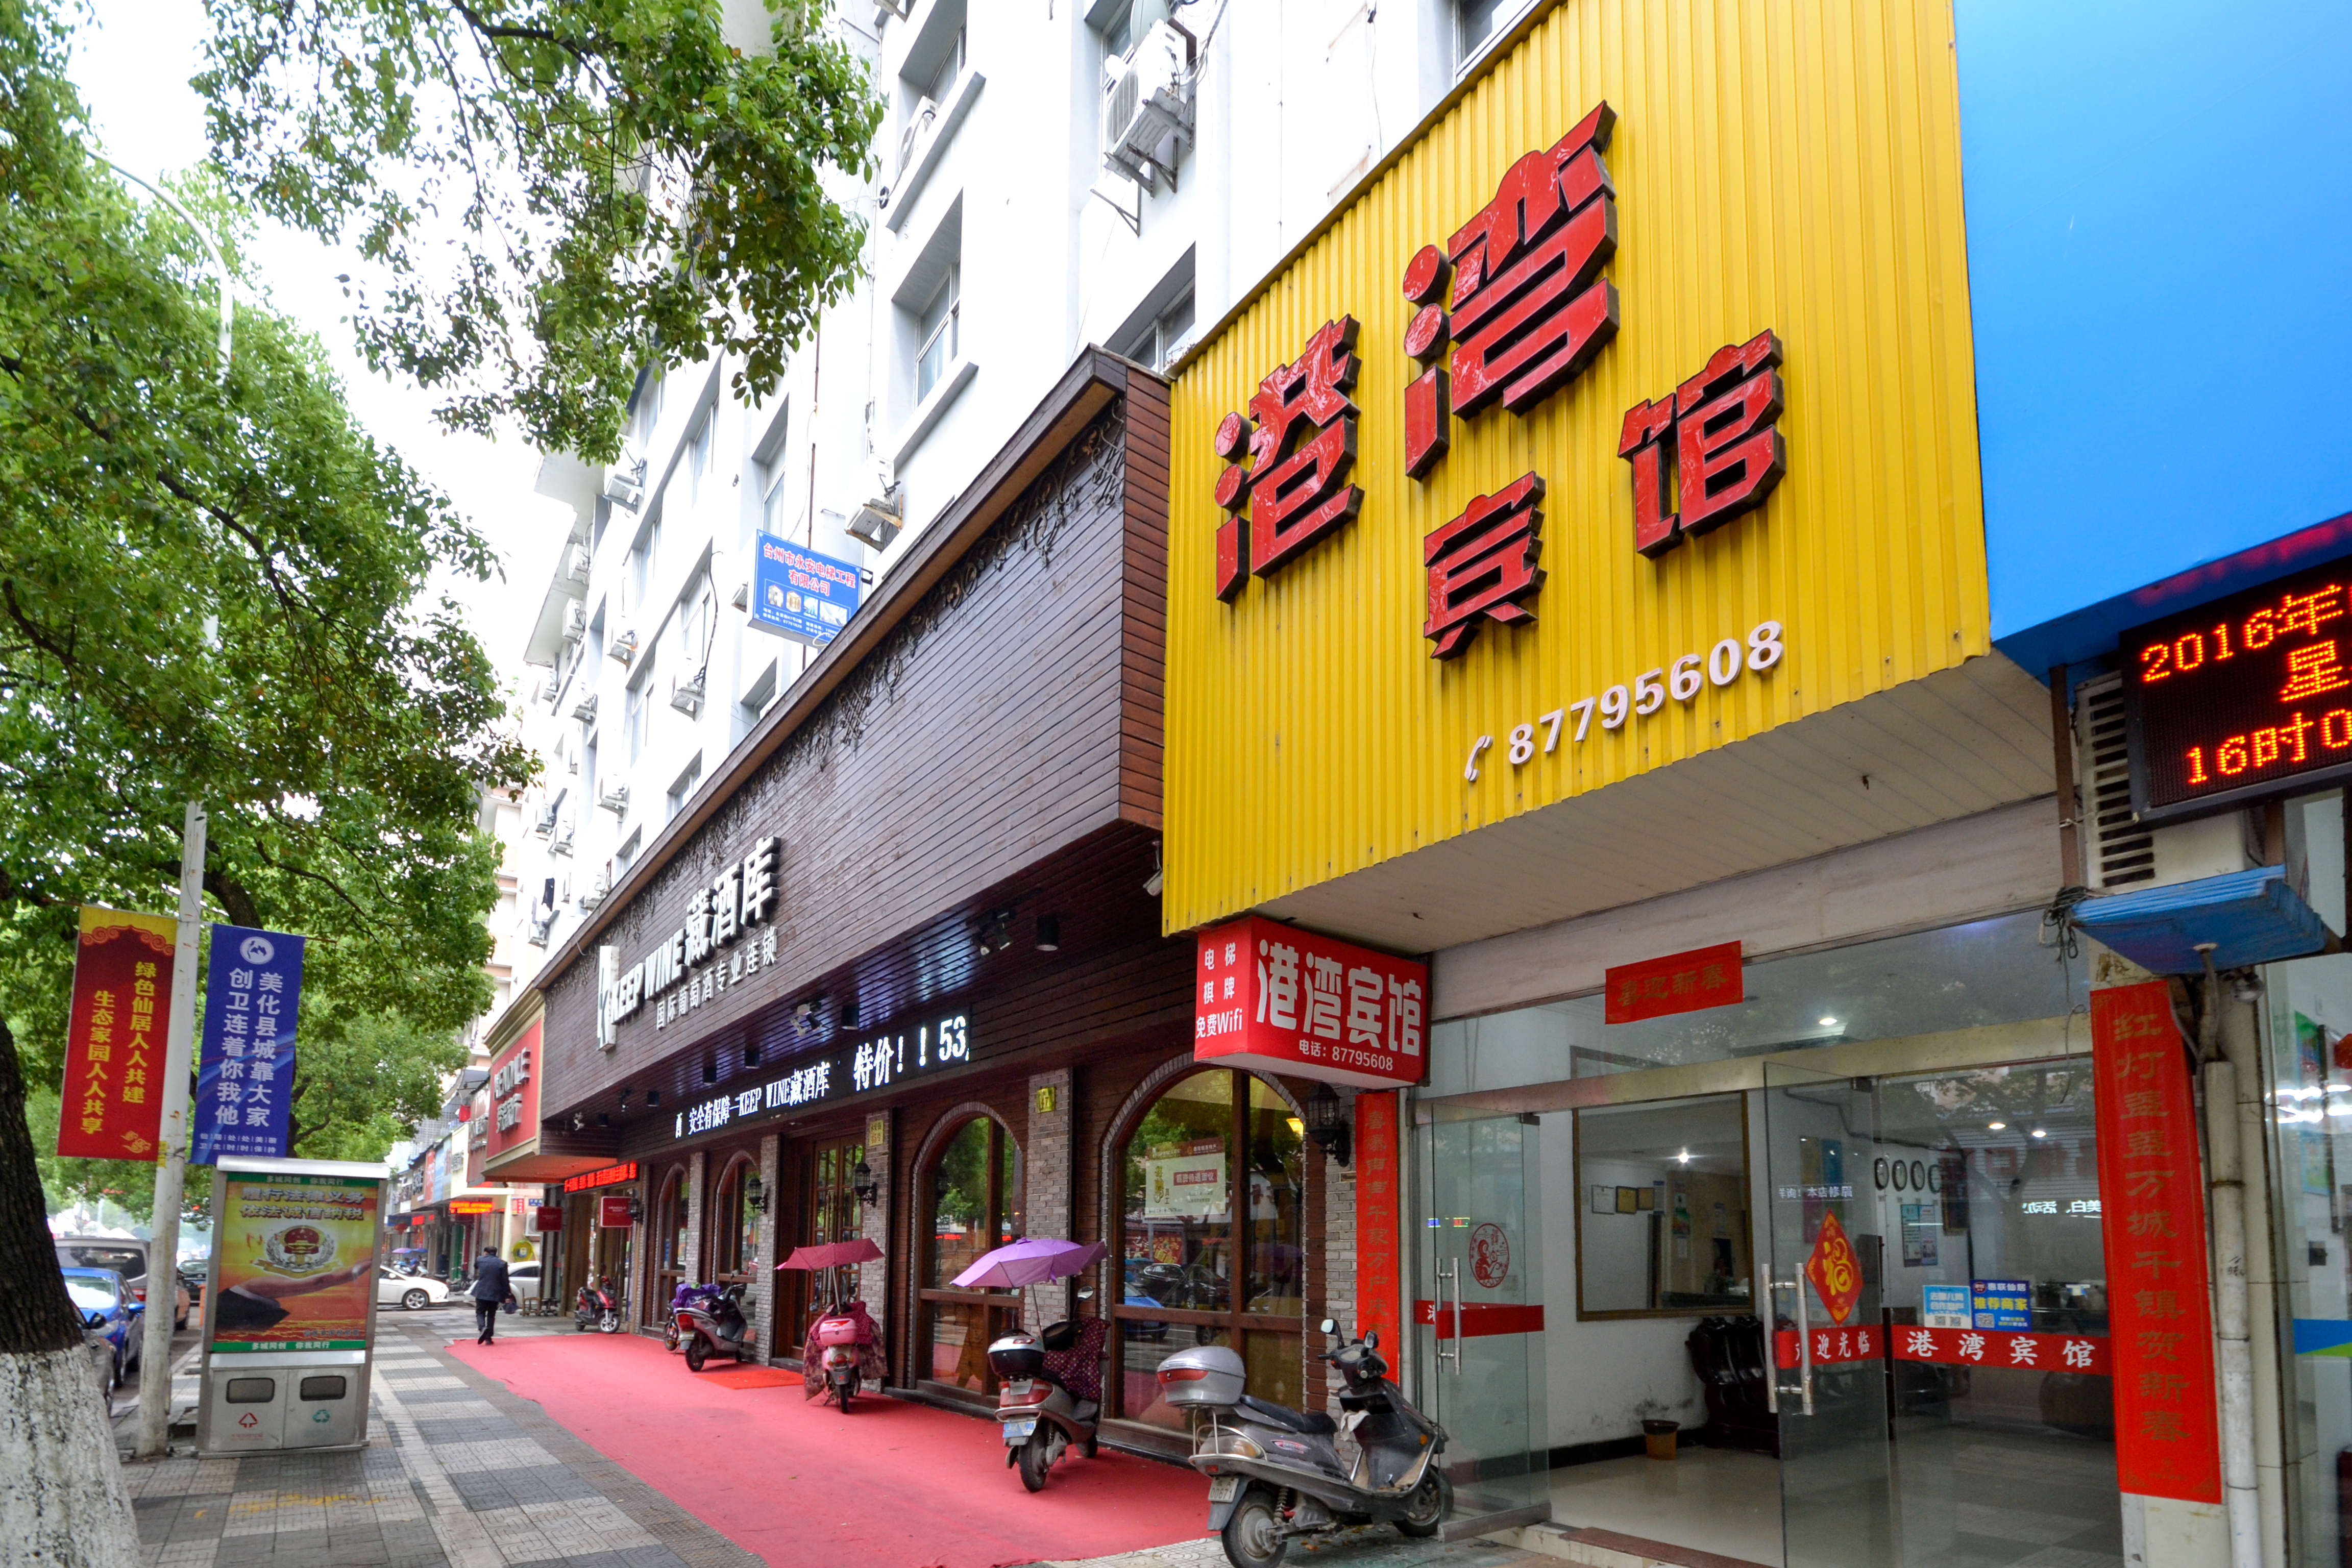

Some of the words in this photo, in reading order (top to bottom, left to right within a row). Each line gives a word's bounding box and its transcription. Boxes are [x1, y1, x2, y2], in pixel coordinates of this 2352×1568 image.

[764, 543, 856, 588] 台州市永安电梯工程
[789, 570, 830, 596] 有限公司
[2141, 584, 2344, 683] 2016年
[1508, 619, 1784, 768] 87795608
[2280, 639, 2350, 702] 星
[2186, 708, 2352, 785] 16时0
[656, 926, 777, 1031] 国际葡萄酒专业连锁
[1205, 942, 1236, 970] 电梯
[1617, 963, 1728, 1007] 喜迎新春
[611, 963, 645, 1025] KEEP
[1204, 976, 1235, 1005] 棋牌
[1257, 939, 1422, 1057] 港湾宾馆
[122, 961, 156, 1104] 绿色仙居人人共建
[215, 968, 253, 1125] 创卫连着你我他
[246, 972, 283, 1127] 美化县城靠大家
[1196, 1007, 1243, 1040] 免费Wifi
[81, 990, 115, 1135] 生态家园人人共享
[240, 1205, 364, 1220] 依法诚信纳税
[241, 1187, 365, 1204] 履行法律义务
[1822, 1238, 1854, 1296] 福
[1974, 1297, 2028, 1311] 推荐商家
[1906, 1330, 2096, 1369] 港湾宾馆
[1210, 1488, 1233, 1500] 00671
